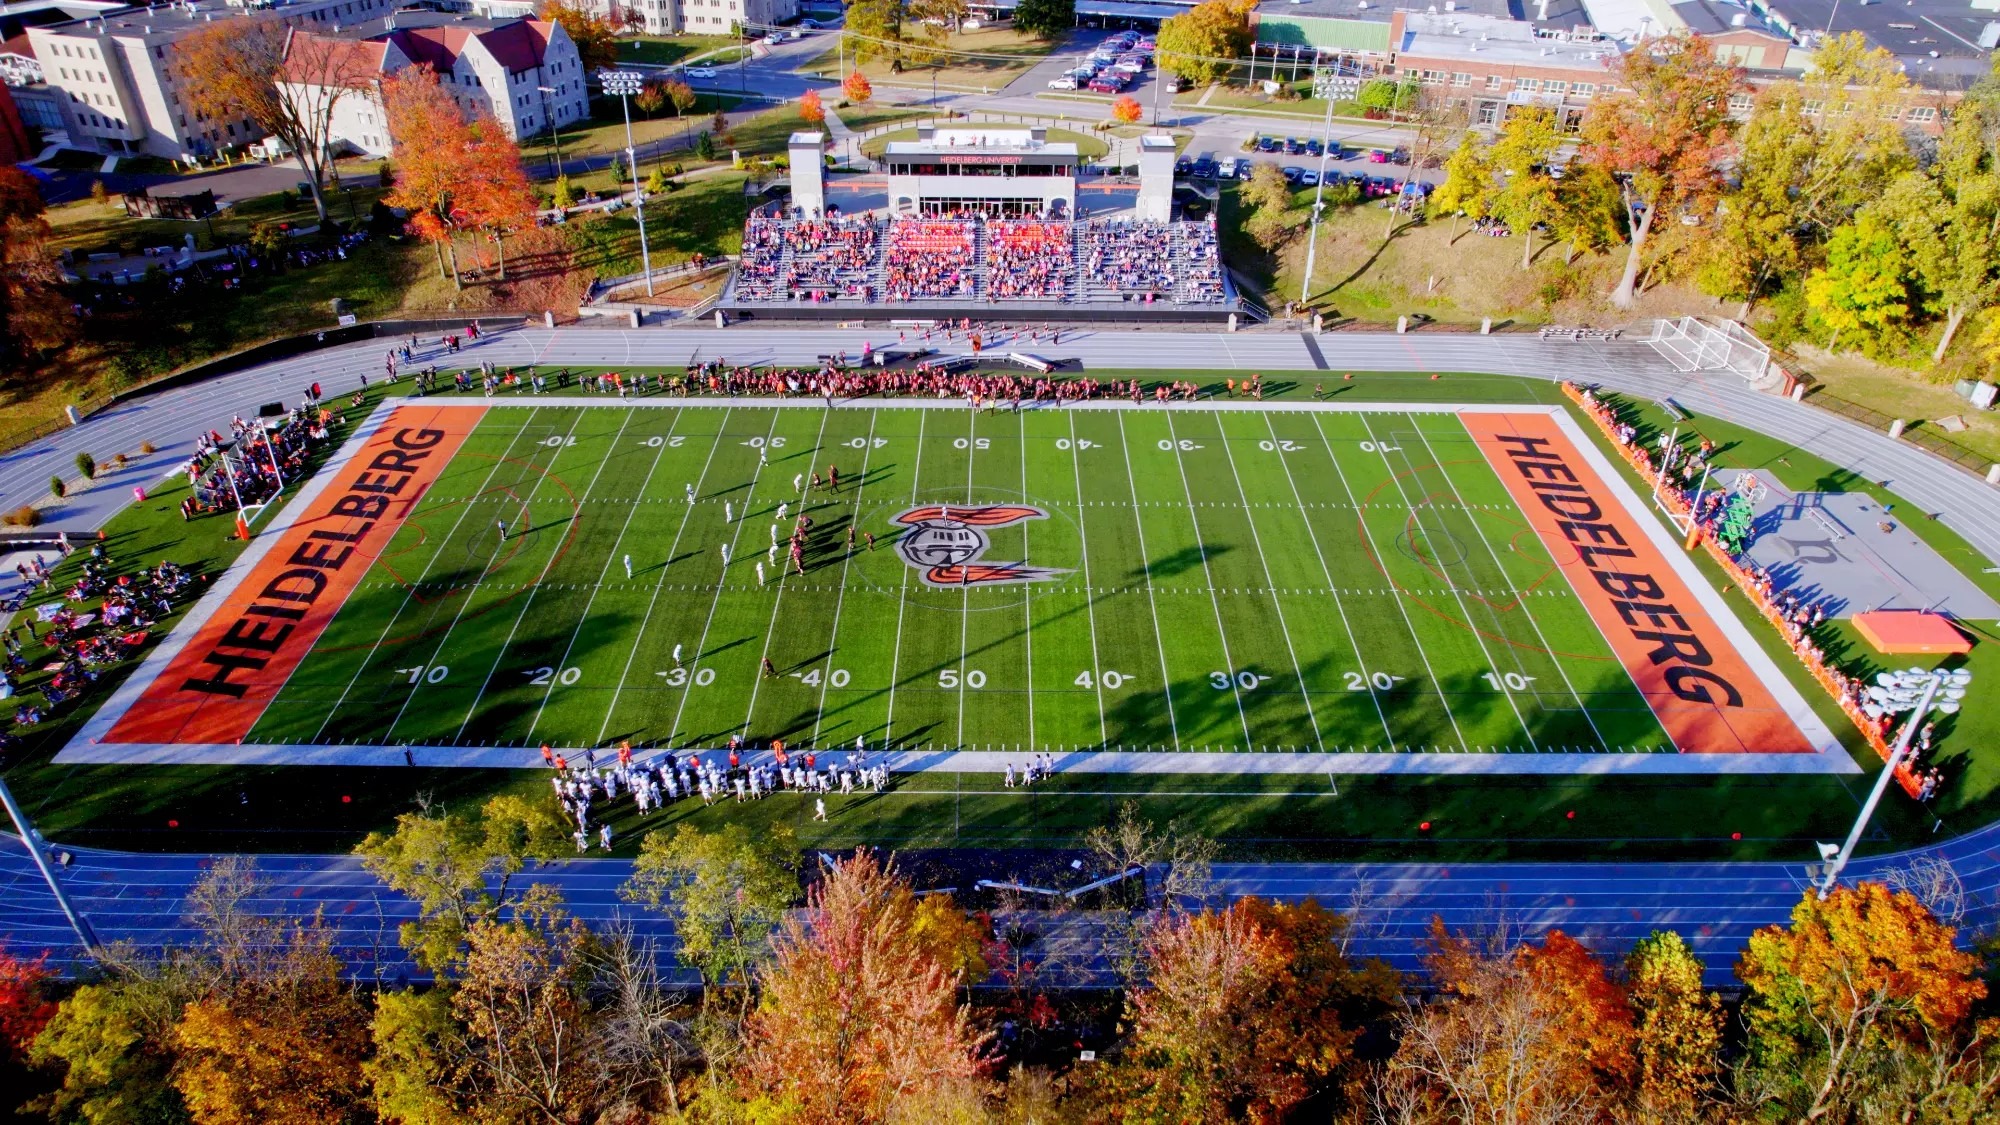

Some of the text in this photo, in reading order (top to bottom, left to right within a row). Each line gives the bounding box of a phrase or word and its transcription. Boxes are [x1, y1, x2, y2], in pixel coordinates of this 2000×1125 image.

[940, 155, 1023, 164] HEIDELBERG UNIVERSITY
[546, 435, 577, 448] 10
[648, 435, 687, 448] 20
[750, 436, 787, 448] 30
[851, 436, 889, 449] 40
[953, 437, 991, 450] 50
[1056, 438, 1093, 450] 40
[1158, 439, 1195, 451] 30
[1259, 440, 1298, 452] 20
[1360, 440, 1395, 453] 10
[180, 428, 446, 700] HEIDELBERG
[1495, 433, 1744, 708] HEIDELBERG
[407, 665, 450, 685] 10
[530, 667, 582, 686] 20
[666, 667, 716, 687] 30
[802, 669, 851, 688] 40
[938, 669, 987, 689] 50
[1074, 670, 1123, 690] 40
[1210, 671, 1259, 691] 30
[1343, 671, 1393, 691] 20
[1482, 672, 1527, 692] 10
